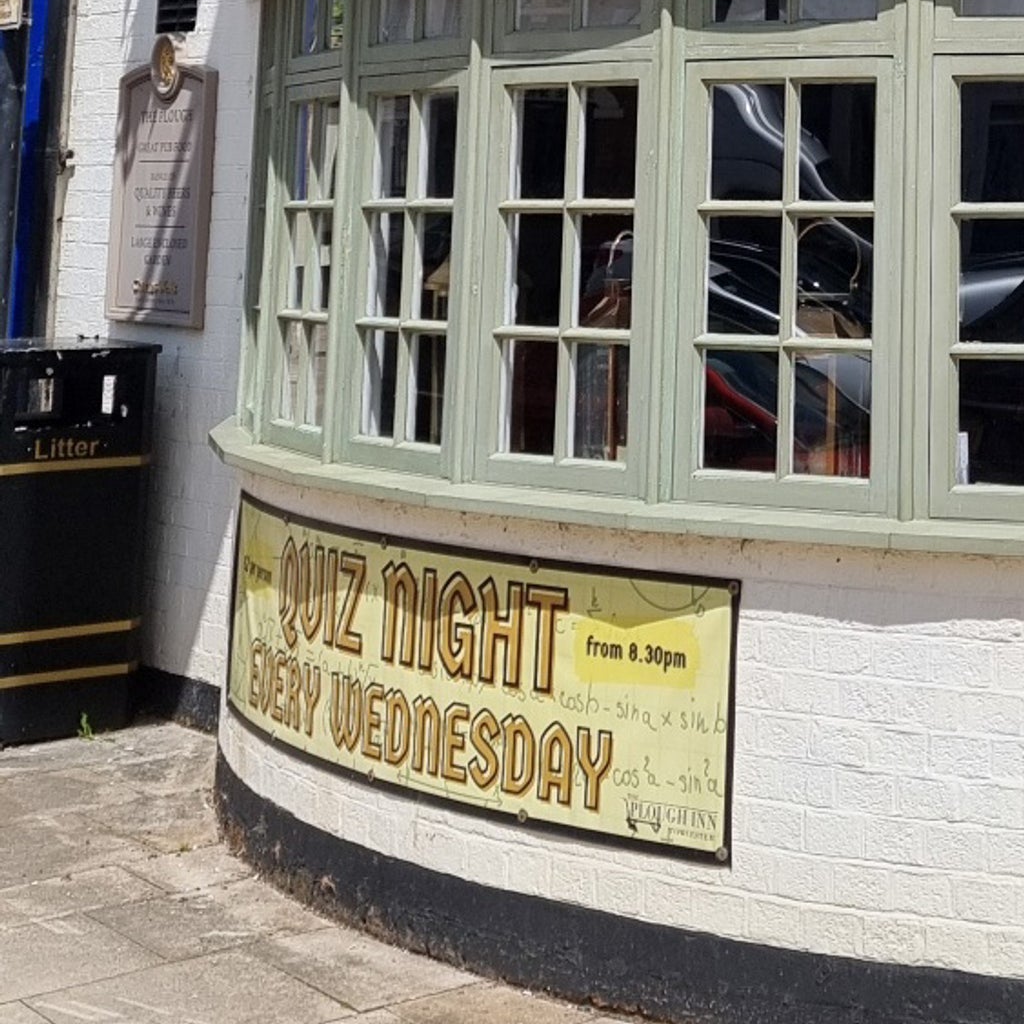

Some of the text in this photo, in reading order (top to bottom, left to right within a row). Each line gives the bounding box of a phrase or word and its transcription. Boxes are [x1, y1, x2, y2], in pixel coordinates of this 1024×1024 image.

[158, 108, 193, 123] PLOUGH
[134, 187, 167, 202] QUALITY
[34, 436, 100, 460] Litter
[279, 536, 570, 695] QUIZ NIGHT
[586, 634, 687, 673] from 8.30pm
[248, 638, 614, 812] EVERY WEDNESDAY
[631, 801, 718, 831] PLOUGH INN
